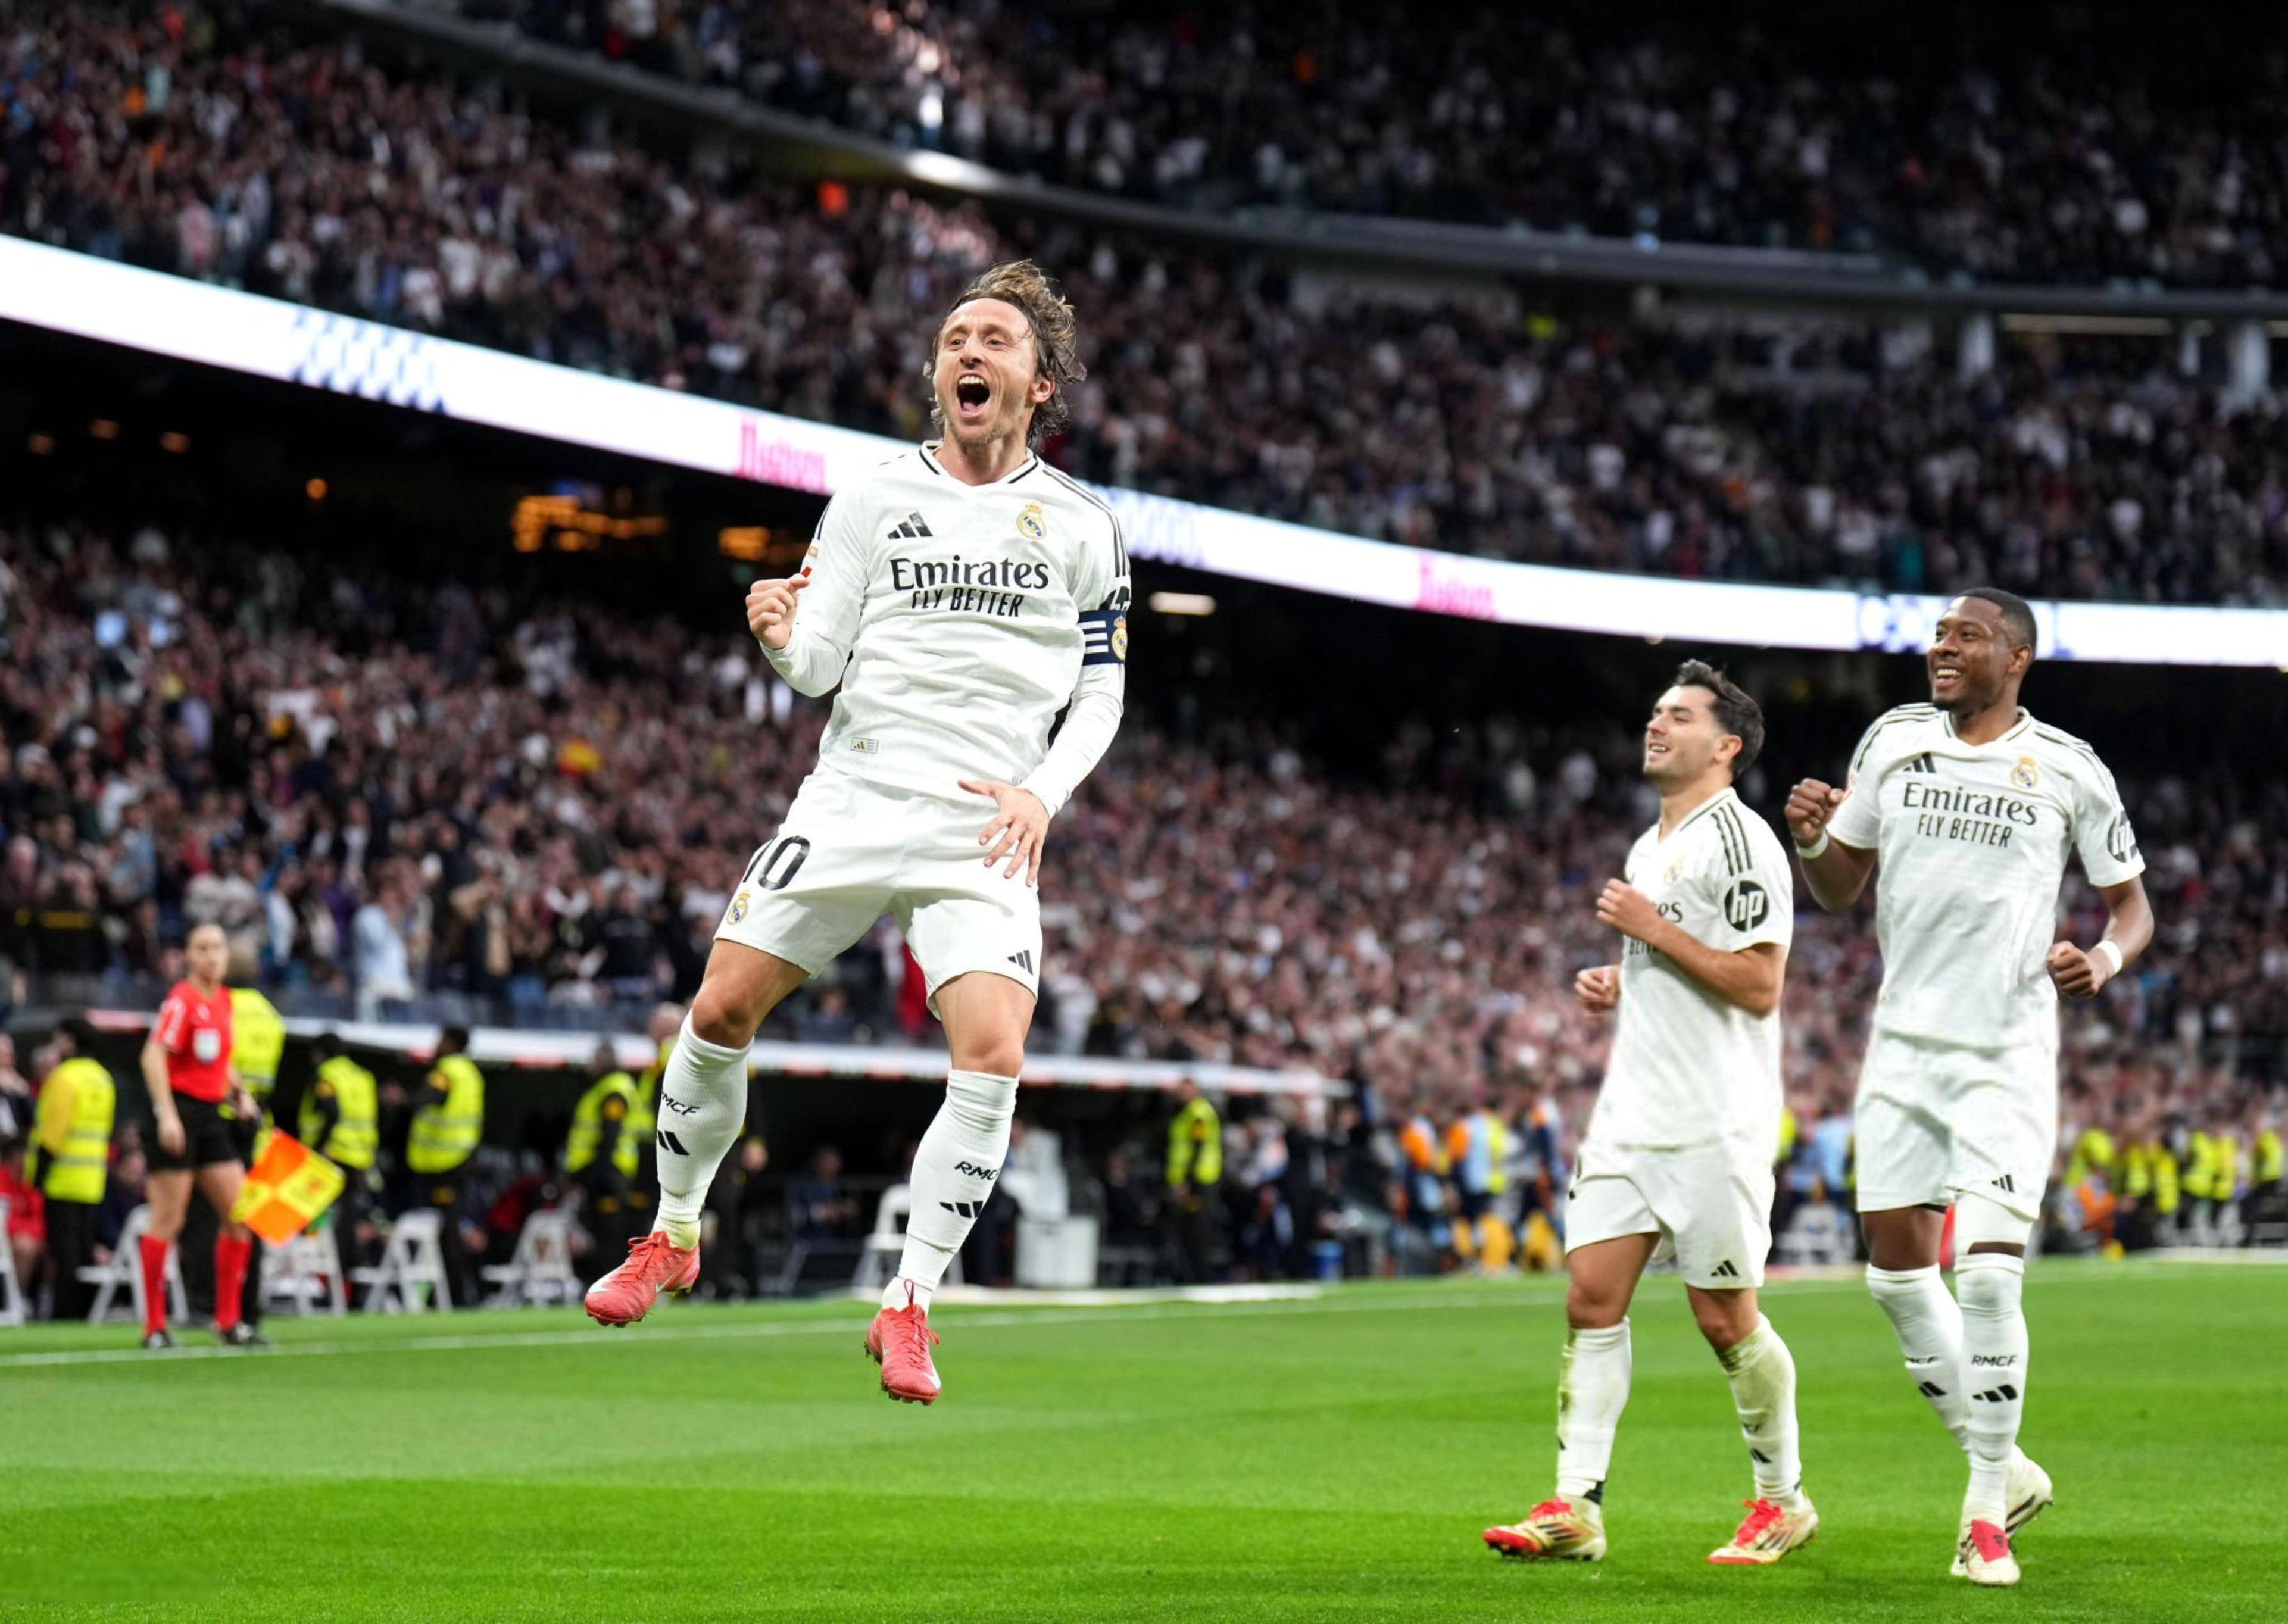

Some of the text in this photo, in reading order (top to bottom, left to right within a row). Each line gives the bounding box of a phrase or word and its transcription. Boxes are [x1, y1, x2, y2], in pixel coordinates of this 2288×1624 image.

[889, 555, 1049, 591] Emirates
[911, 587, 1025, 617] FLY BETTER
[1903, 782, 2038, 826] Emirates
[1917, 814, 2013, 848] FLY BETTER
[1728, 881, 1765, 932] hp
[661, 1091, 701, 1116] MCF
[954, 1161, 1000, 1180] RMC
[1971, 1354, 2018, 1367] RMCF
